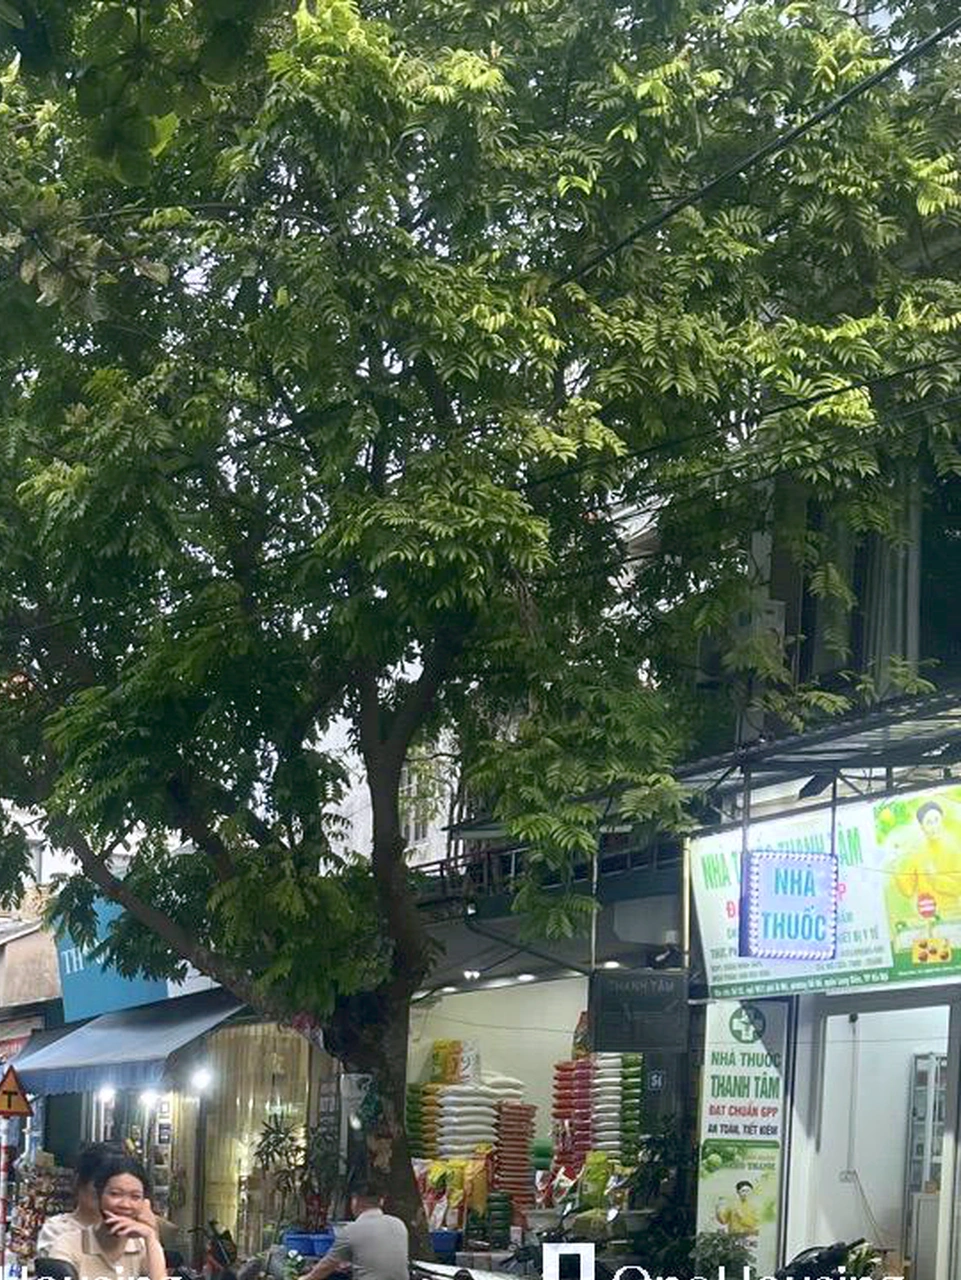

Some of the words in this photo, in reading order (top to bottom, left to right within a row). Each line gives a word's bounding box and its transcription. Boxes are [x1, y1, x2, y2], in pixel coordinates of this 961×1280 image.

[774, 864, 816, 897] NHÀ
[761, 905, 827, 942] THUỐC
[711, 1075, 750, 1098] THANH
[754, 1071, 780, 1099] TÂM
